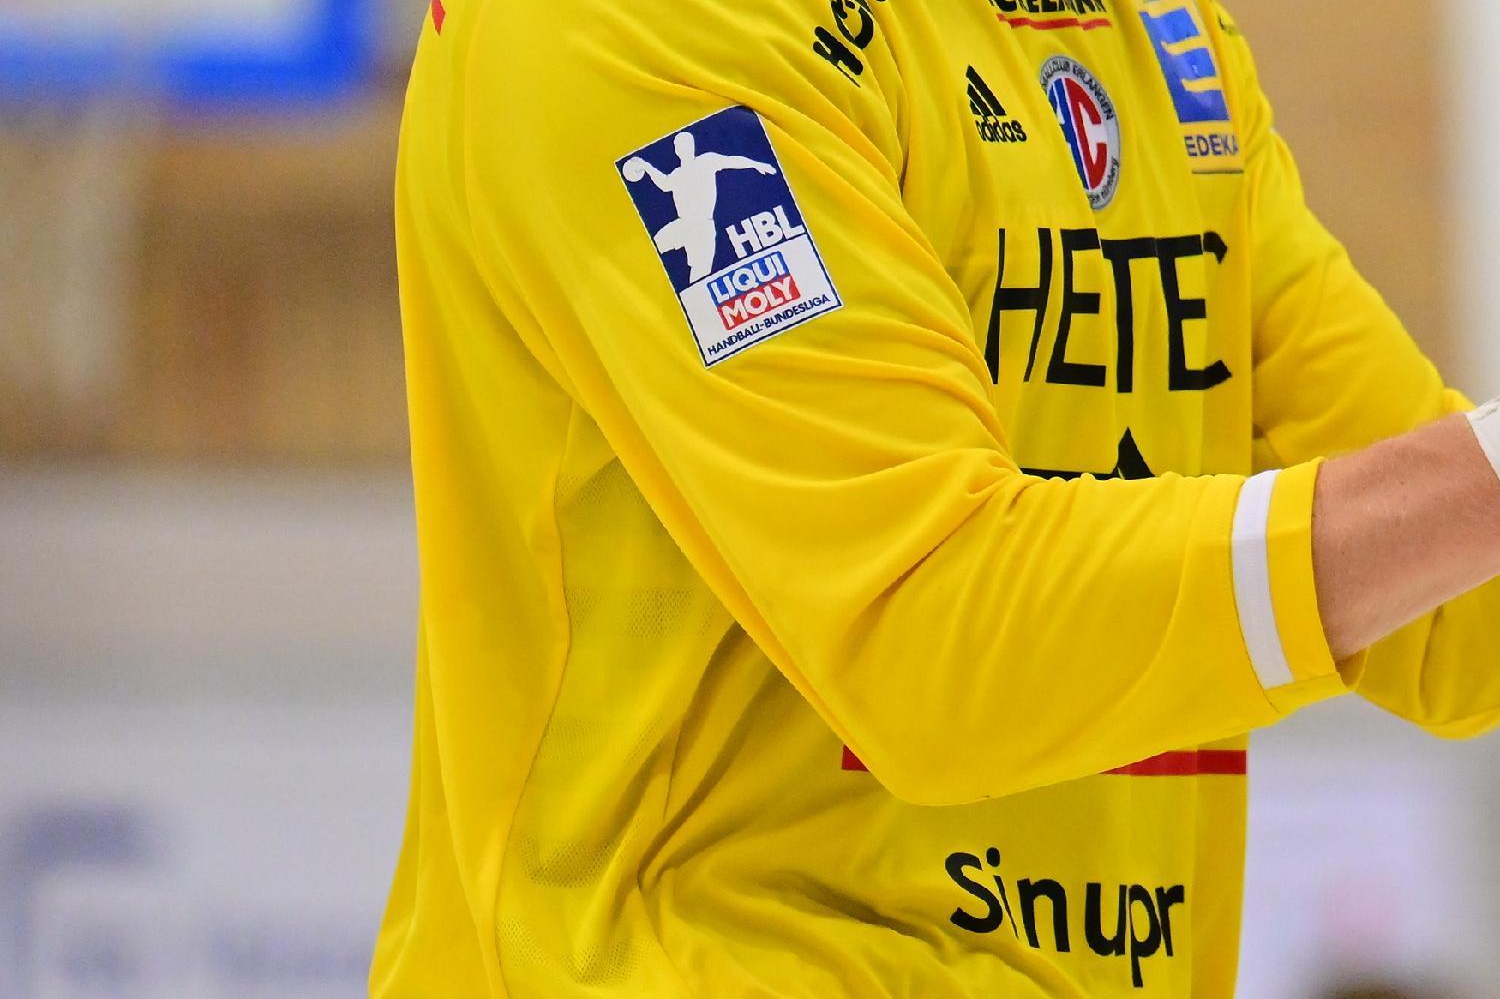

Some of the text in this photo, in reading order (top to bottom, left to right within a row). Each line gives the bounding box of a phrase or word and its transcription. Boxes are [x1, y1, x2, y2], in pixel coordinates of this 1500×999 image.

[725, 204, 806, 260] HBL
[709, 253, 788, 304] LIQUI
[721, 275, 797, 329] MOLY
[707, 293, 832, 357] HANDBALL-BUNDESLIGA
